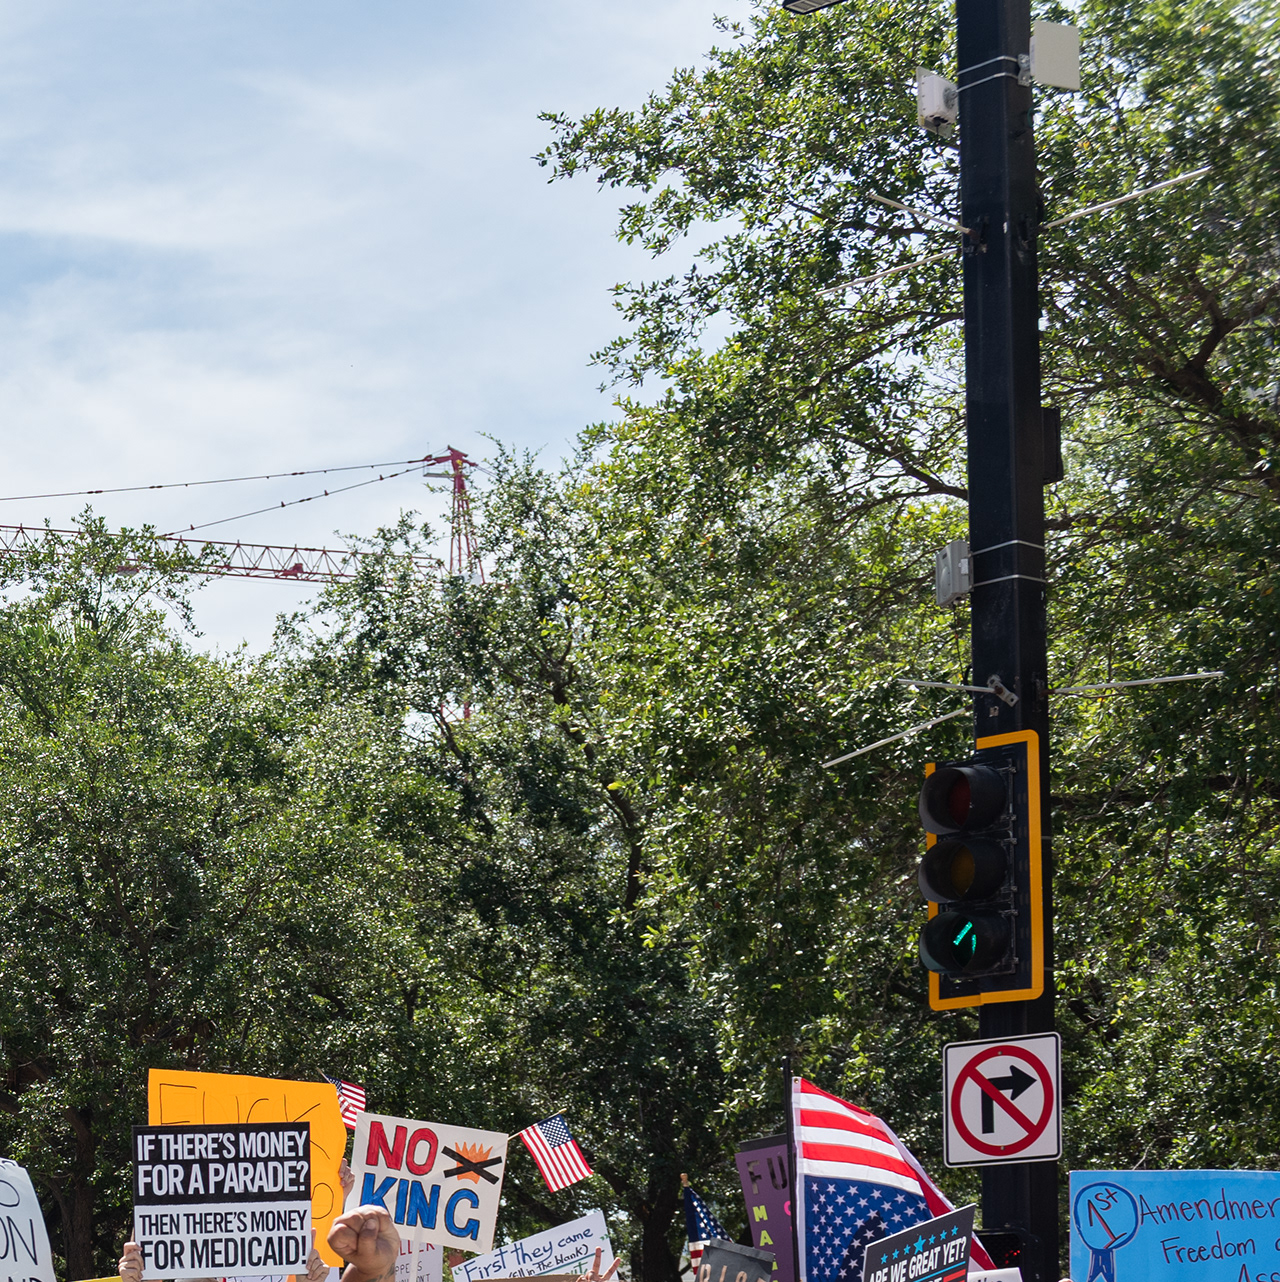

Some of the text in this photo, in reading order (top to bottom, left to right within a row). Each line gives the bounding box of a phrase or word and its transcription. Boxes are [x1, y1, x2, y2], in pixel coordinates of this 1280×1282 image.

[137, 1131, 308, 1161] IF THERE’S MONEY
[366, 1121, 439, 1176] NO
[138, 1161, 309, 1196] FOR A PARADE?
[139, 1210, 308, 1235] THEN THERE’S MONEY
[361, 1173, 480, 1241] KING
[140, 1236, 307, 1270] FOR MEDICAID!
[511, 1241, 553, 1265] they
[909, 1246, 941, 1279] GREAT
[943, 1236, 967, 1265] YET?
[1160, 1230, 1255, 1264] Freedom
